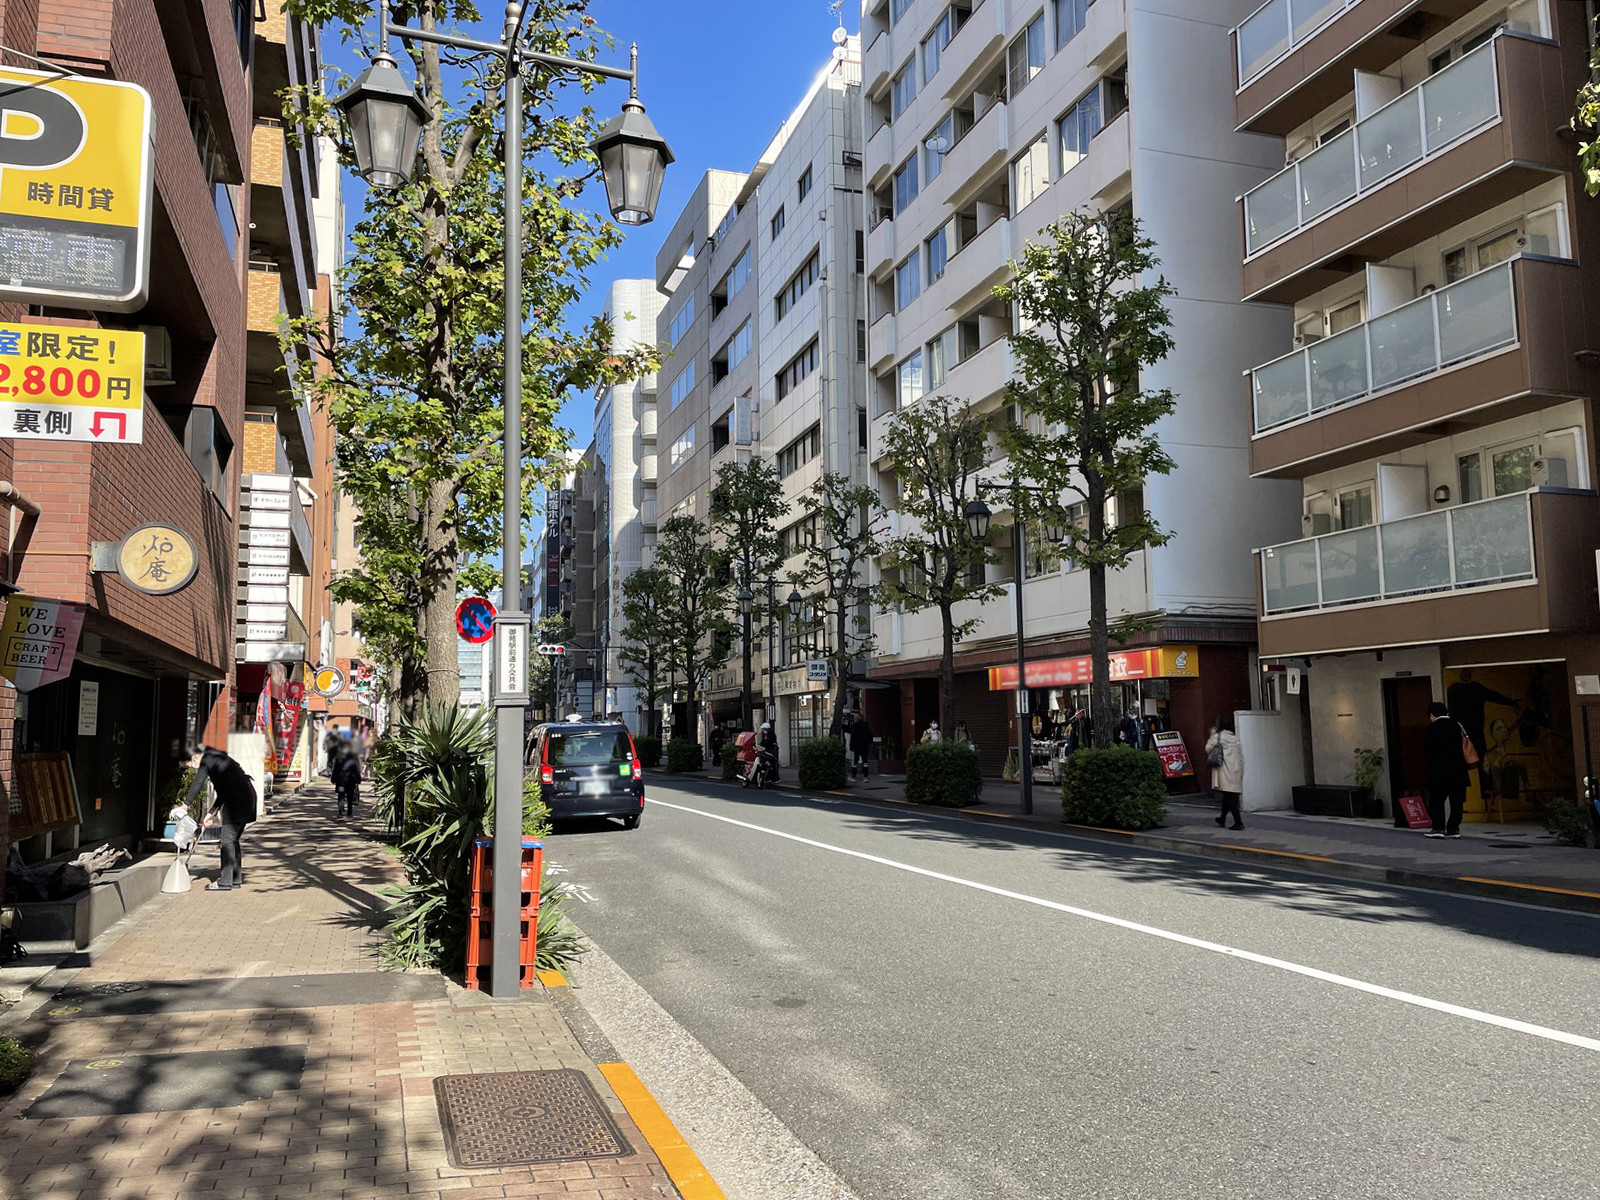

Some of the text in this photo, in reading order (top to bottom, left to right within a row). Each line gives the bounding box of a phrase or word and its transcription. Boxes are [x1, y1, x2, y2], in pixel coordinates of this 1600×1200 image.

[27, 182, 115, 212] 時間貸
[13, 408, 73, 435] 裏側
[138, 534, 174, 583] 炉庵
[19, 606, 49, 620] WE
[14, 622, 67, 639] LOVE
[13, 641, 60, 655] CRAFT
[11, 653, 48, 665] BEER
